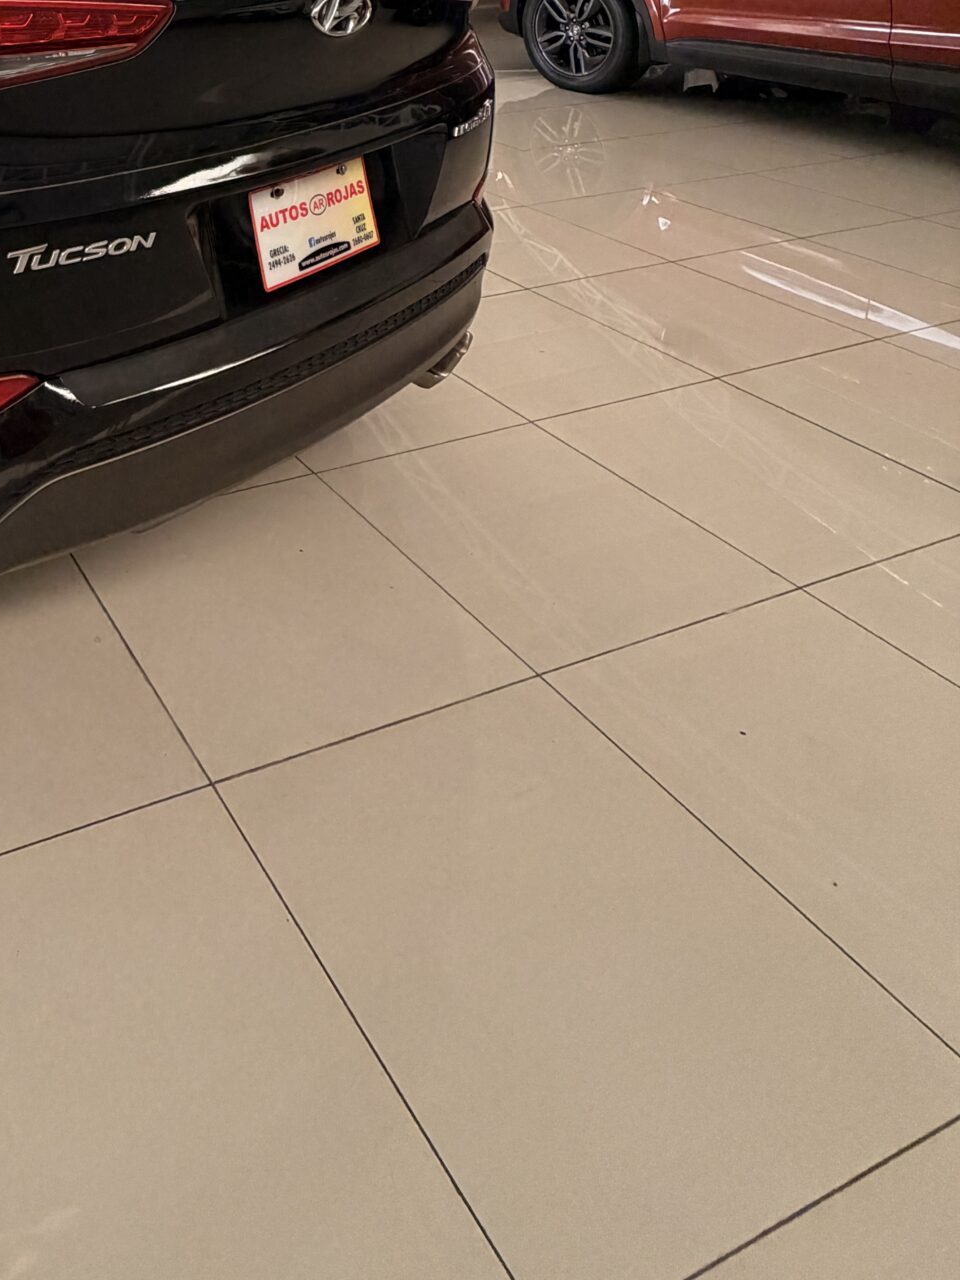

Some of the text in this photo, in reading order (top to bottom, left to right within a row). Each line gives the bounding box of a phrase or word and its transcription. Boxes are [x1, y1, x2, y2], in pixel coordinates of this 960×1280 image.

[260, 180, 365, 232] AUTOS AR ROJAS
[6, 232, 157, 274] TUCSON
